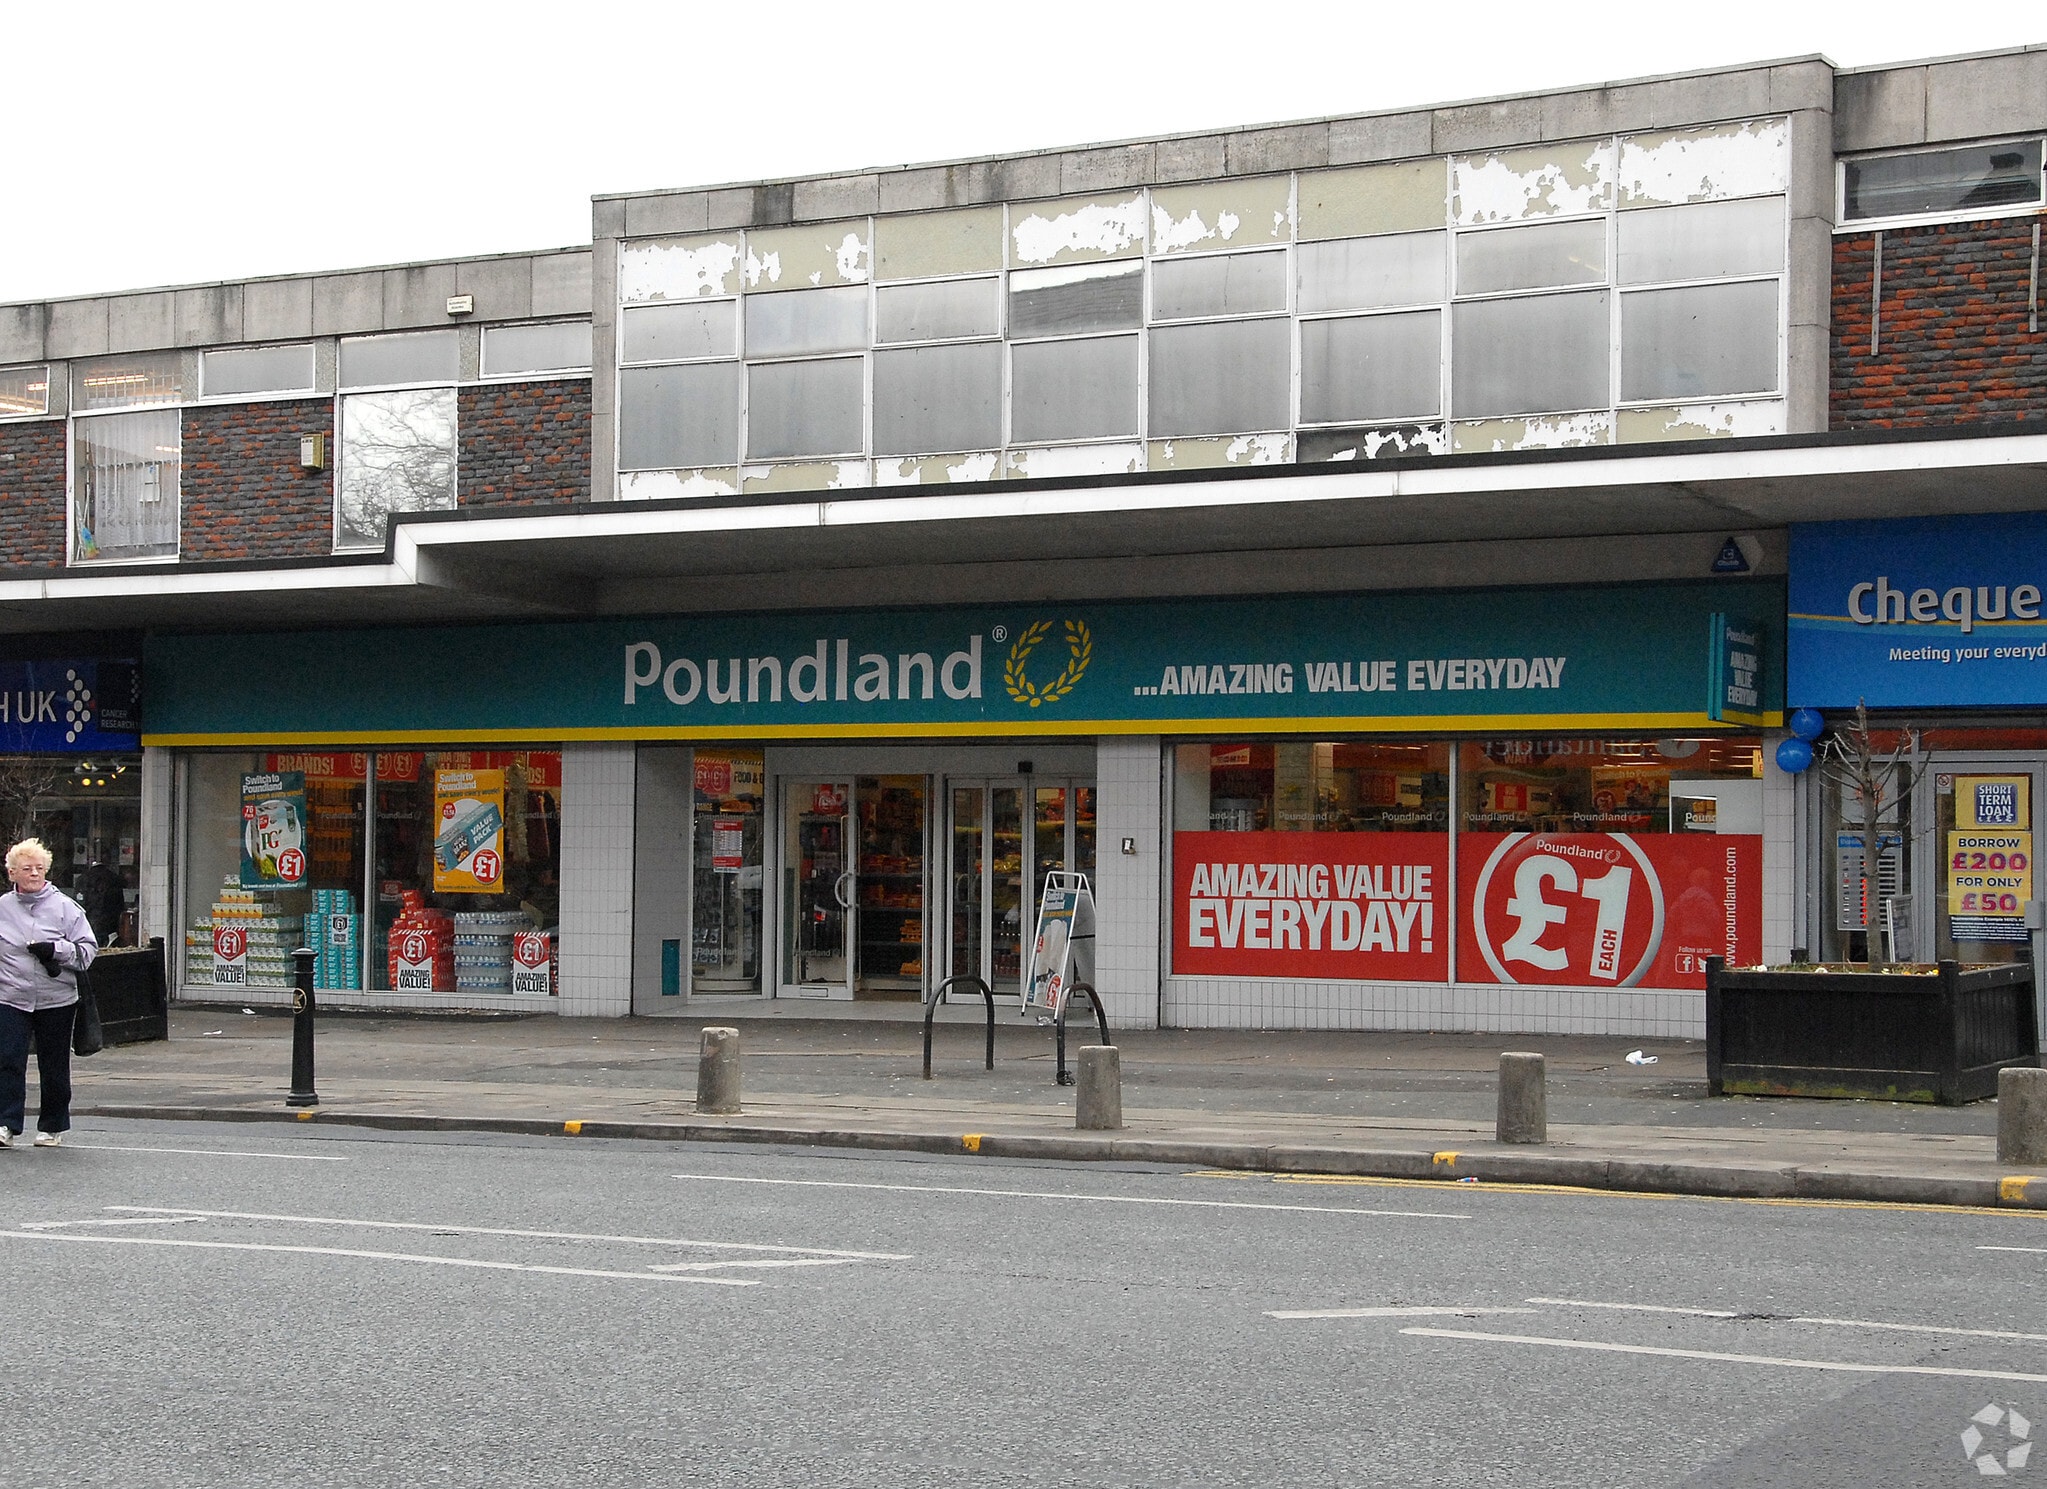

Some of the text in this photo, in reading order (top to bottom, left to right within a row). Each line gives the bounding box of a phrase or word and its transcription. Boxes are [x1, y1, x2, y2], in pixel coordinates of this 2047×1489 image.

[1848, 576, 2041, 633] Cheque
[1889, 643, 2047, 663] Meeting your everyd
[624, 635, 983, 705] Poundland
[1134, 657, 1566, 695] ...AMAZING VALUE EVERYDAY
[18, 690, 57, 723] UK
[101, 709, 128, 718] CANCER
[101, 720, 135, 729] RESEARCH
[277, 756, 334, 775] BRANDS!
[244, 774, 279, 786] Switch to
[439, 774, 463, 784] Switch
[733, 771, 751, 783] FOOD
[242, 782, 282, 794] Poundland
[437, 780, 477, 792] Poundland
[1978, 785, 2012, 794] SHORT
[1979, 795, 2012, 805] TERM
[1278, 810, 1328, 822] Poundland
[1382, 811, 1433, 822] Poundland
[1463, 811, 1515, 822] Poundland
[1574, 811, 1627, 822] Poundland
[1979, 805, 2012, 816] LOAN
[470, 813, 494, 836] VALUE
[262, 831, 279, 850] PG
[473, 824, 493, 844] PACK
[1536, 839, 1603, 860] Poundland
[1958, 838, 2020, 848] BORROW
[281, 855, 301, 877] £1
[475, 856, 496, 879] £1
[1952, 852, 2028, 871] £200
[1189, 863, 1432, 900] AMAZING VALUE
[1956, 877, 2023, 888] FOR ONLY
[1961, 893, 2018, 913] £50
[1502, 854, 1632, 980] £1
[1189, 898, 1433, 953] EVERYDAY!
[221, 935, 237, 953] £1
[406, 940, 423, 958] £1
[1598, 929, 1617, 972] EACH
[523, 943, 540, 961] £1
[216, 964, 244, 972] AMAZING
[400, 969, 430, 978] AMAZING
[214, 972, 244, 983] VALUE!
[399, 977, 430, 989] VALUE!
[516, 973, 547, 981] AMAZING
[515, 980, 548, 993] VALUE!
